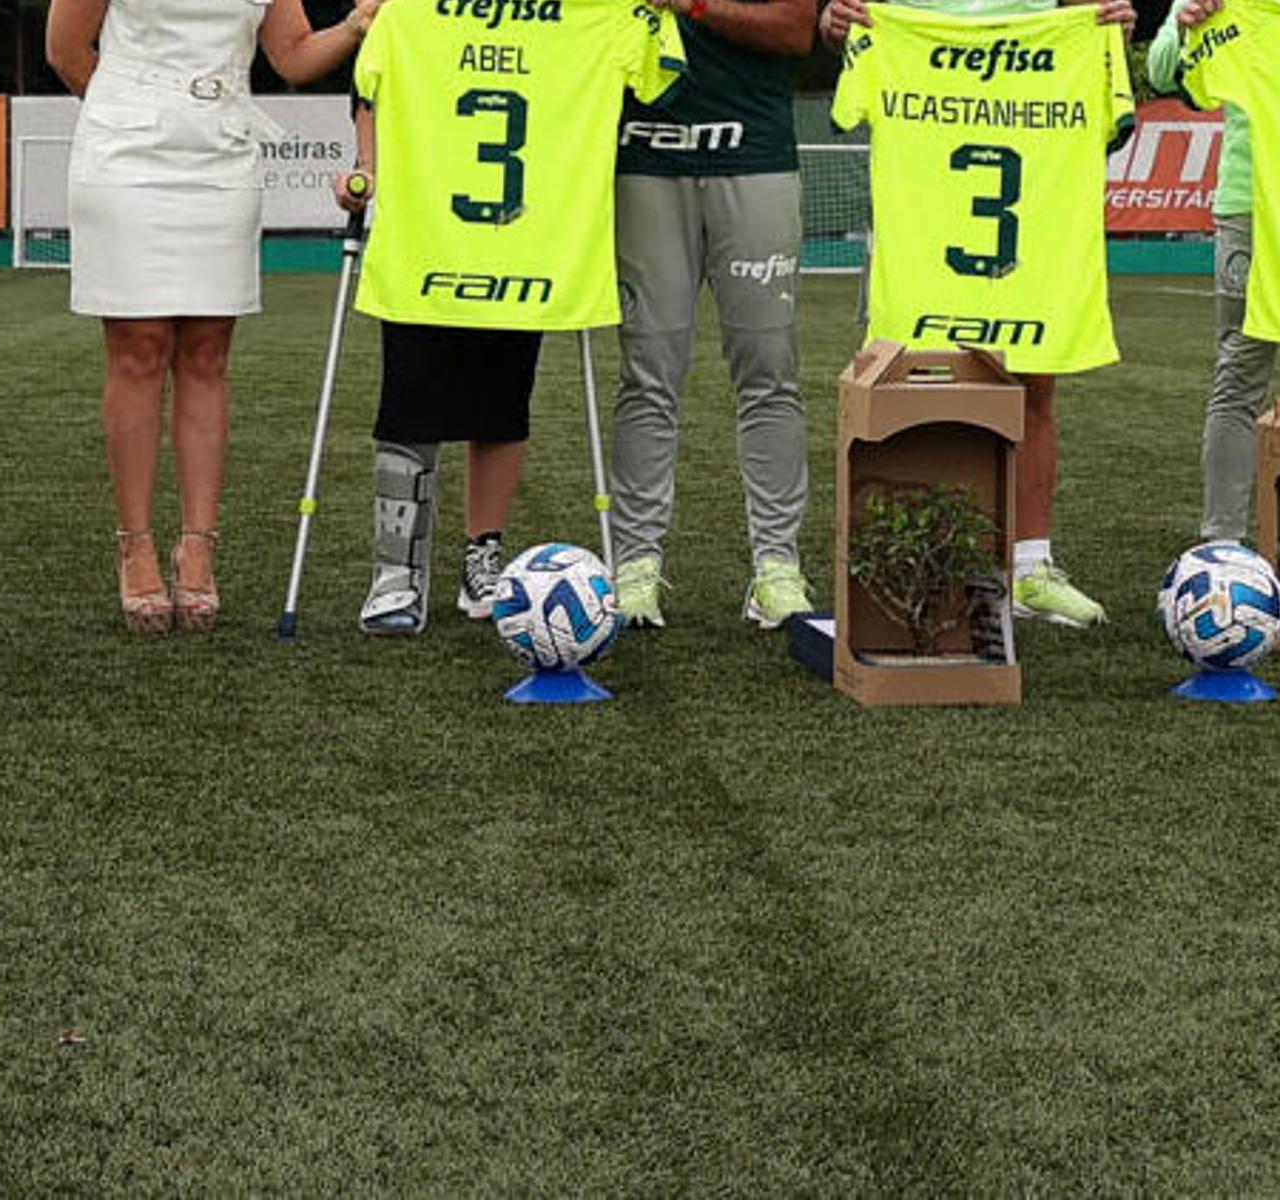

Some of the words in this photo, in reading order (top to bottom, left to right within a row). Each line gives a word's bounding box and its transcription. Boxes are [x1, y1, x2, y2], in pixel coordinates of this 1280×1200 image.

[459, 44, 530, 74] ABEL
[929, 39, 1055, 81] crefisa
[451, 89, 528, 225] 3
[945, 143, 1022, 278] 3
